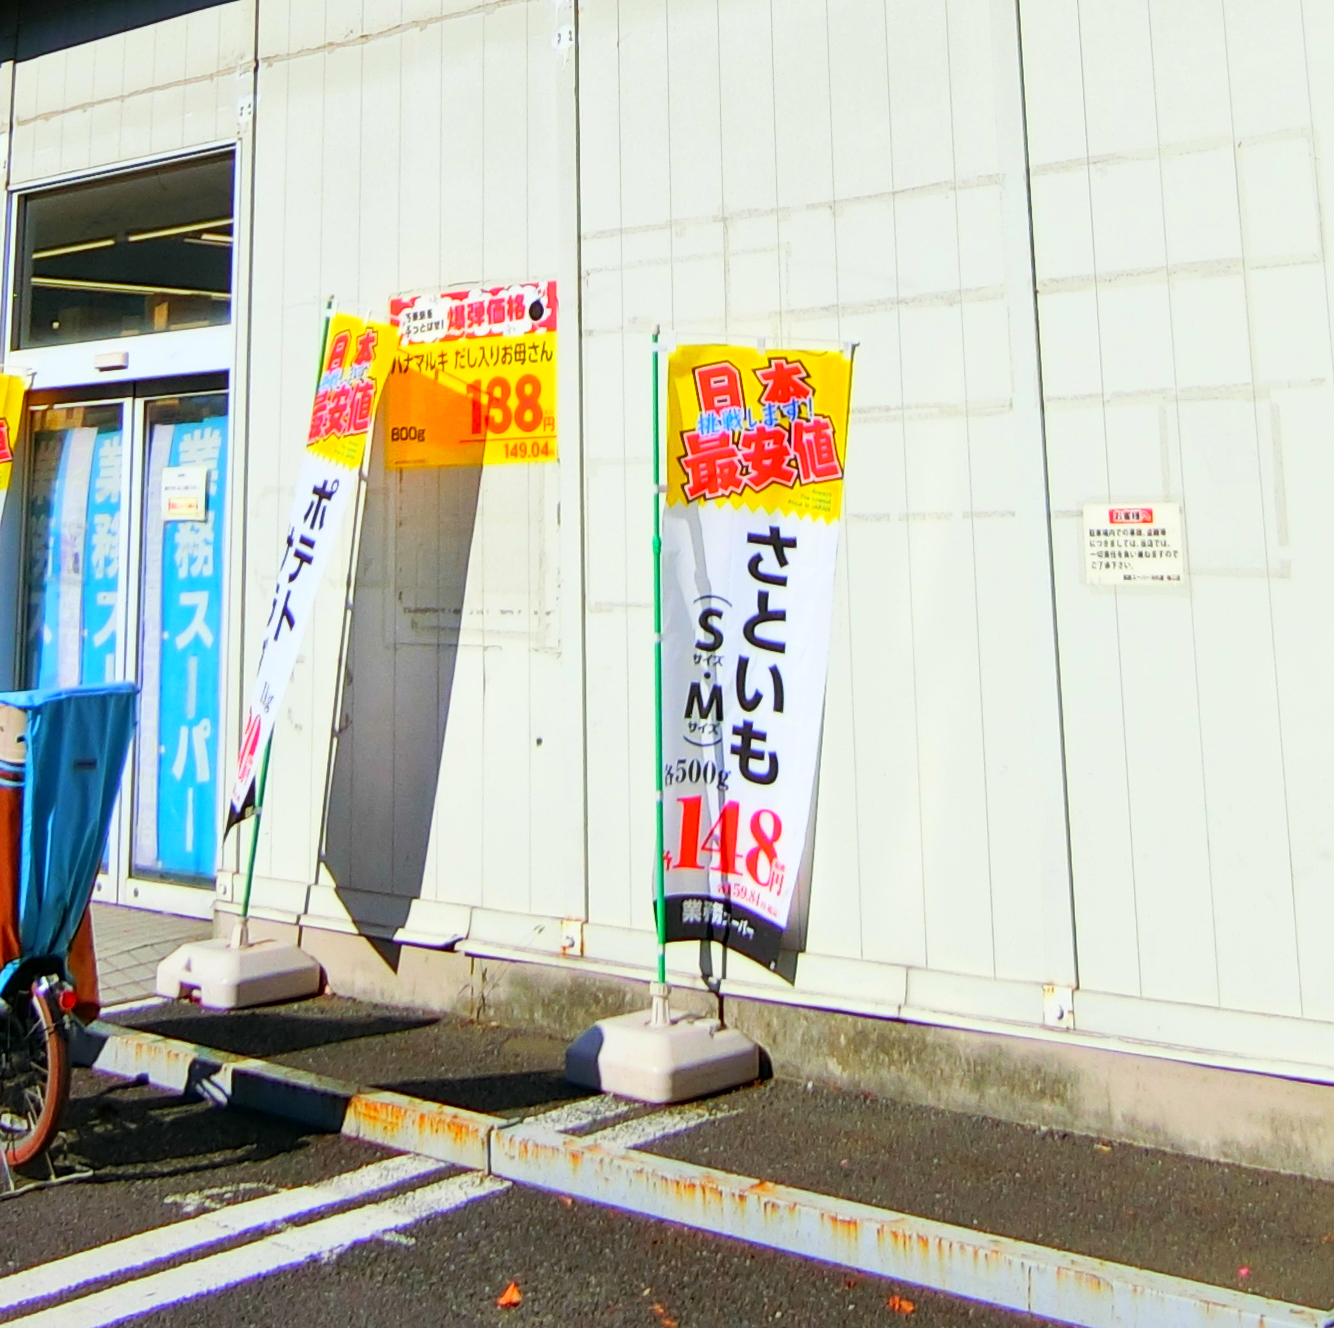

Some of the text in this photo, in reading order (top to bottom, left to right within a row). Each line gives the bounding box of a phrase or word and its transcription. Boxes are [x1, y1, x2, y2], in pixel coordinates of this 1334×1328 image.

[448, 293, 526, 331] 爆弾価格
[327, 328, 378, 372] 日本
[391, 341, 554, 374] ハナマルキ だし入りお母さん
[693, 358, 814, 415] 日本
[391, 427, 426, 442] 800g
[679, 416, 842, 502] 最安値
[274, 479, 340, 641] ポテト
[172, 427, 222, 853] 業務スーパー
[730, 525, 797, 787] さといも
